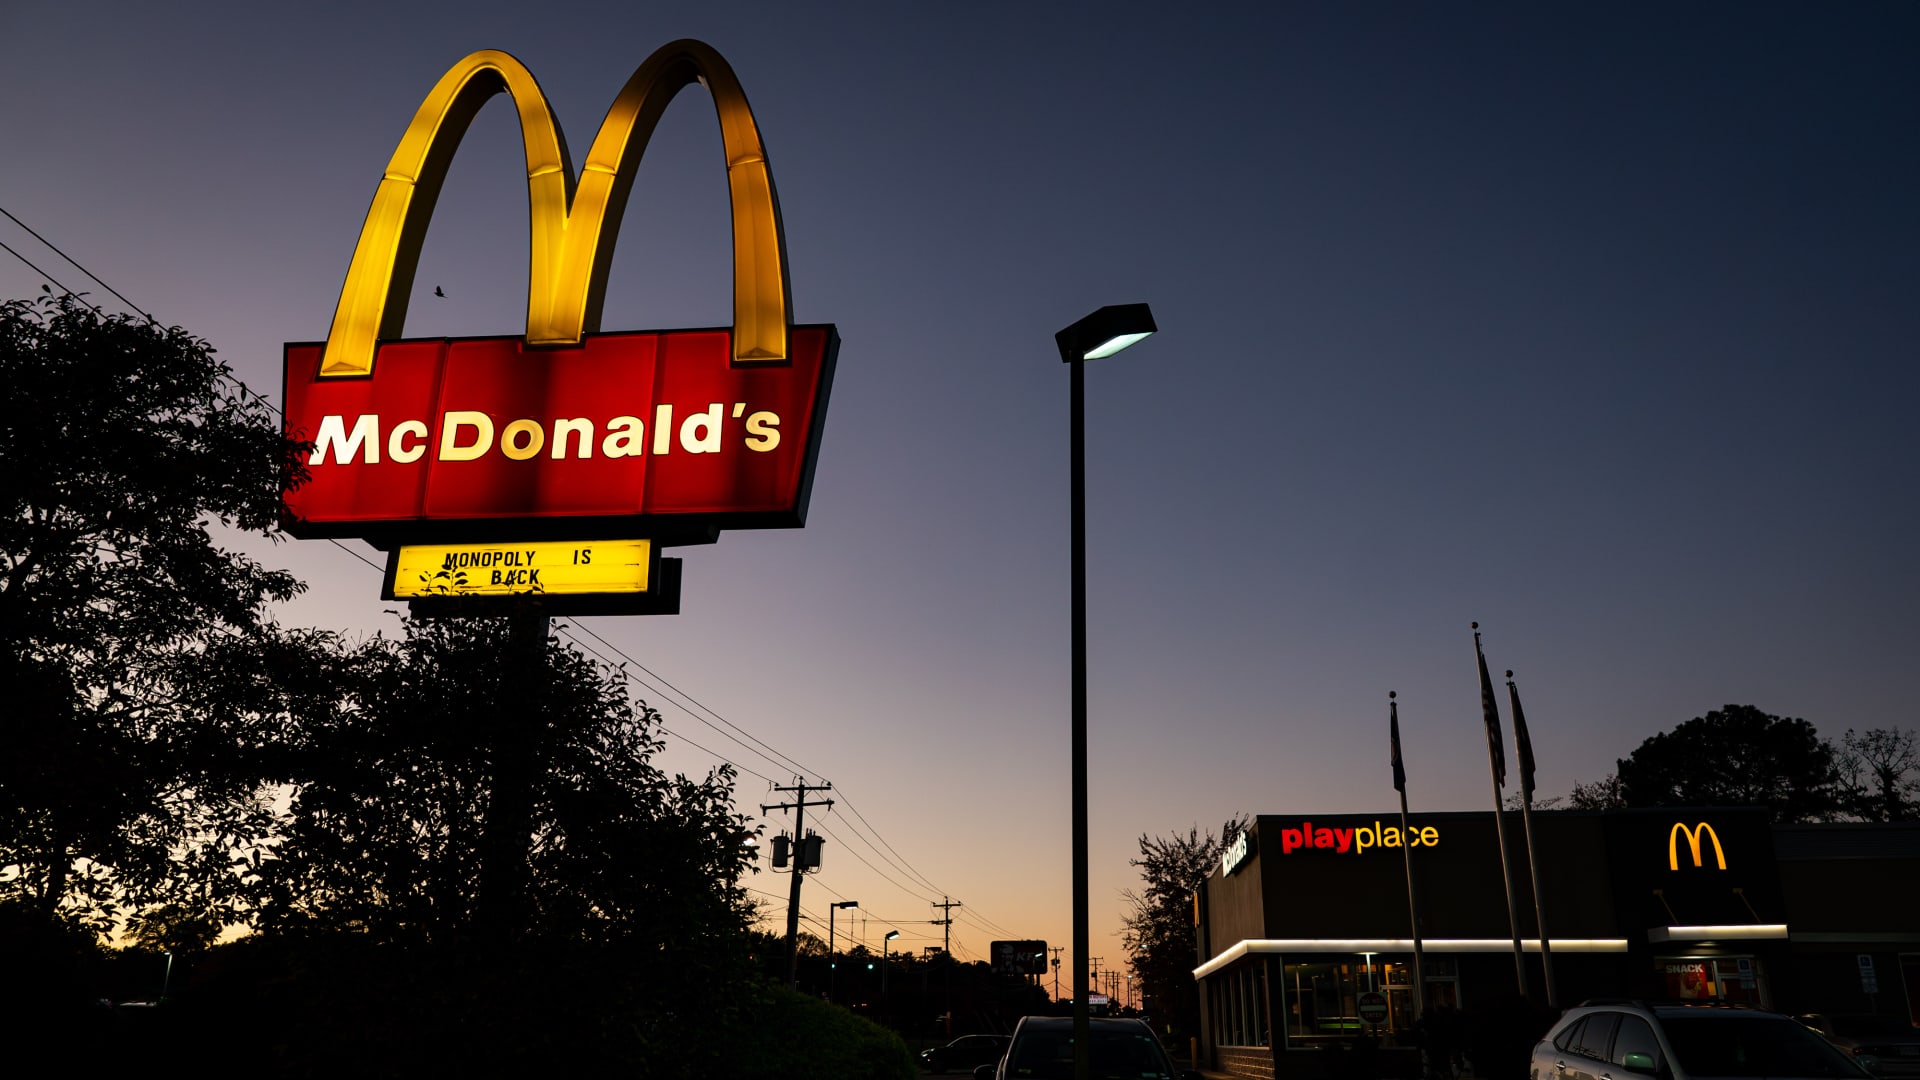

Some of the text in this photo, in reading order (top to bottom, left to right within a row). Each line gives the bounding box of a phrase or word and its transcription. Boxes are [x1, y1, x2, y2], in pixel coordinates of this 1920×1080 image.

[309, 403, 781, 465] McDonald's
[444, 549, 592, 567] MONOPOLY IS
[491, 569, 540, 585] BACK
[1281, 821, 1439, 854] playplace
[1665, 963, 1704, 973] SNACK
